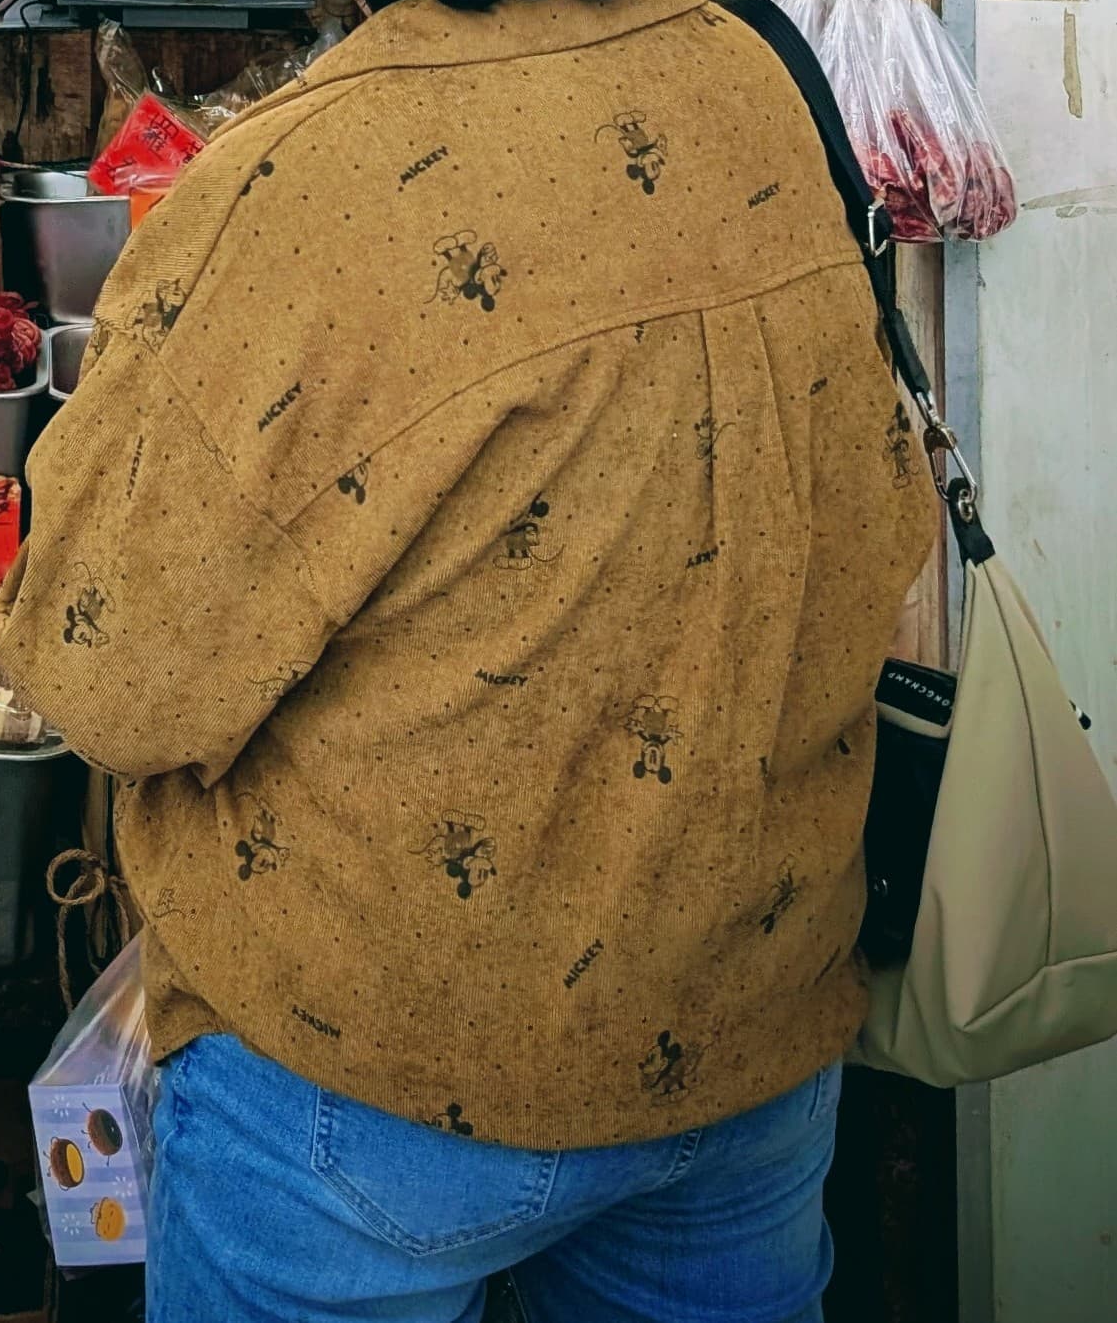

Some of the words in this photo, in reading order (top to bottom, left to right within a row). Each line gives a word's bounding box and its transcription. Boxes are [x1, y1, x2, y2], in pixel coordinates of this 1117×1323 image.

[400, 146, 448, 185] MICKEY
[748, 182, 781, 210] MICKEY
[258, 381, 301, 433] MICKEY
[474, 668, 529, 688] MICKEY
[887, 672, 953, 709] ONGCHAMP
[563, 938, 604, 989] MICKEY
[292, 1004, 341, 1040] MICKEY
